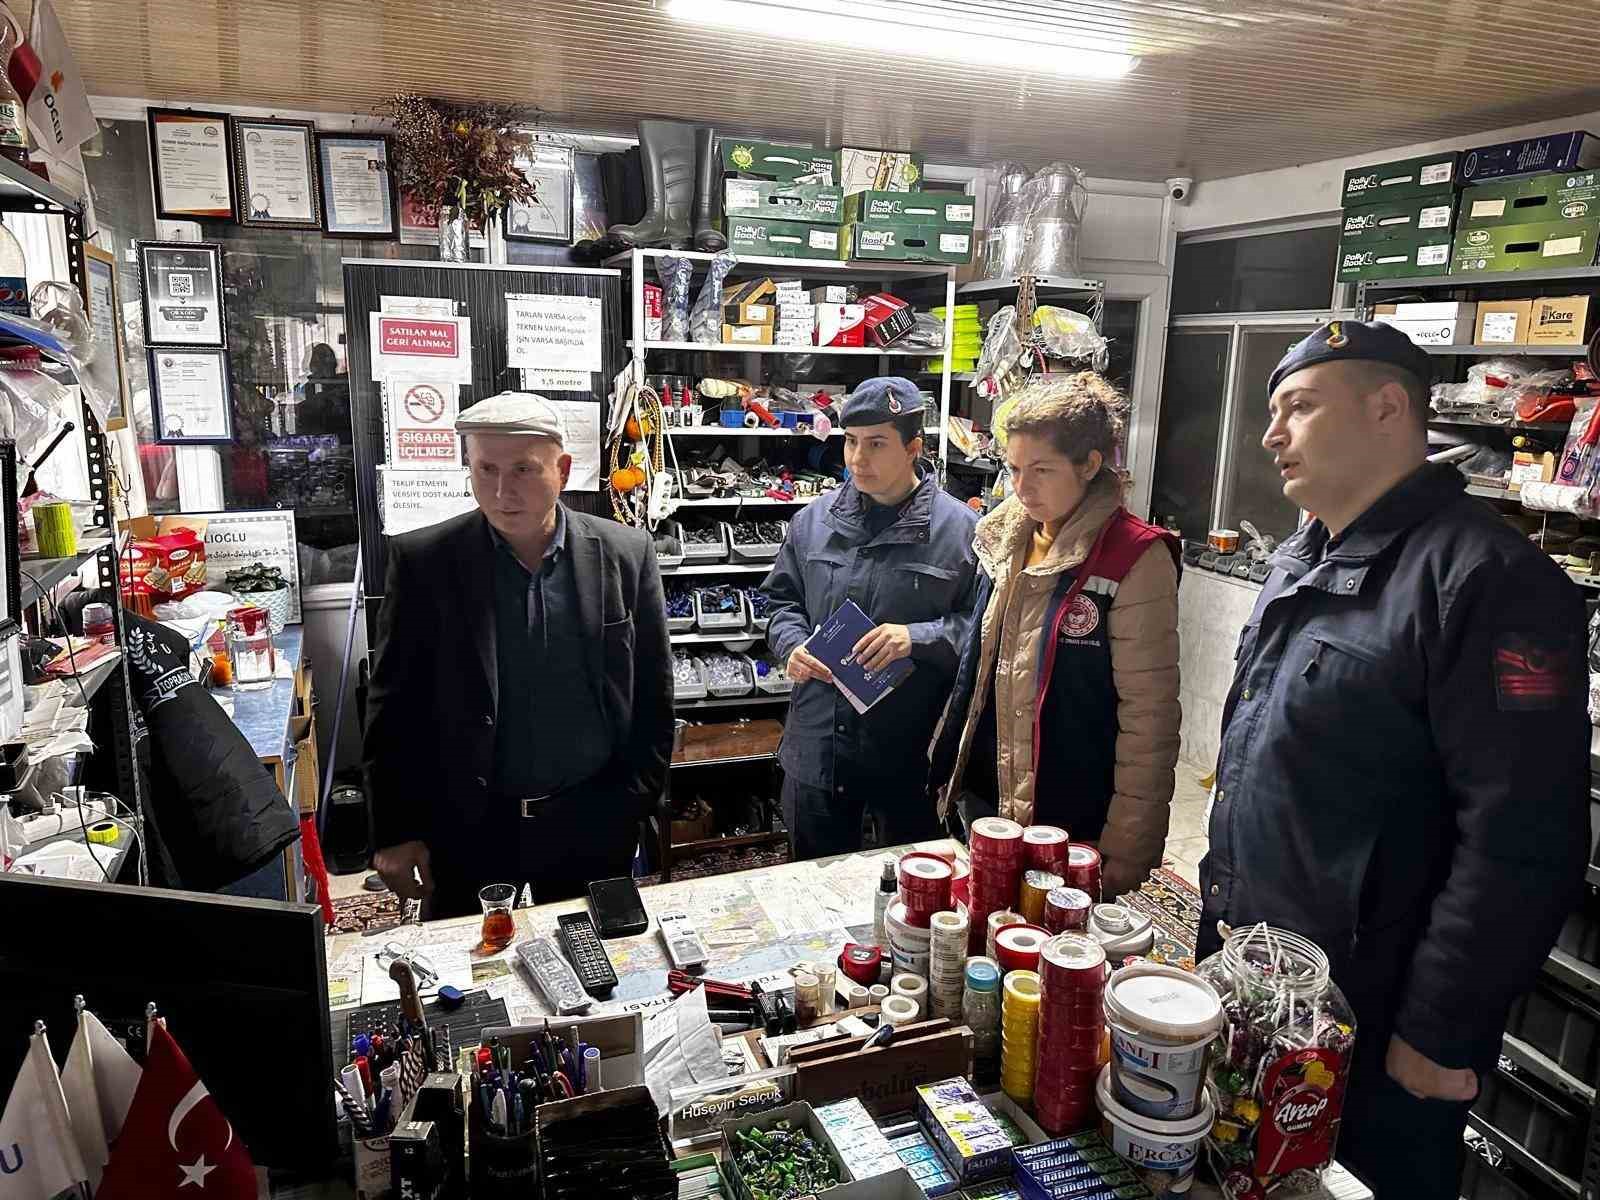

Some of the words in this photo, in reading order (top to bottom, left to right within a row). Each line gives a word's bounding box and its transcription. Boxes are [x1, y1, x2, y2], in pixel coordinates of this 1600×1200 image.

[1549, 311, 1574, 321] Kare
[389, 327, 428, 337] SATILAN
[429, 330, 449, 338] MAL
[411, 339, 452, 349] ALINMAZ
[739, 1087, 783, 1107] Selçuk
[1031, 1152, 1080, 1171] nanelim
[1042, 1165, 1091, 1183] nanelim
[1053, 1177, 1102, 1196] nanelim
